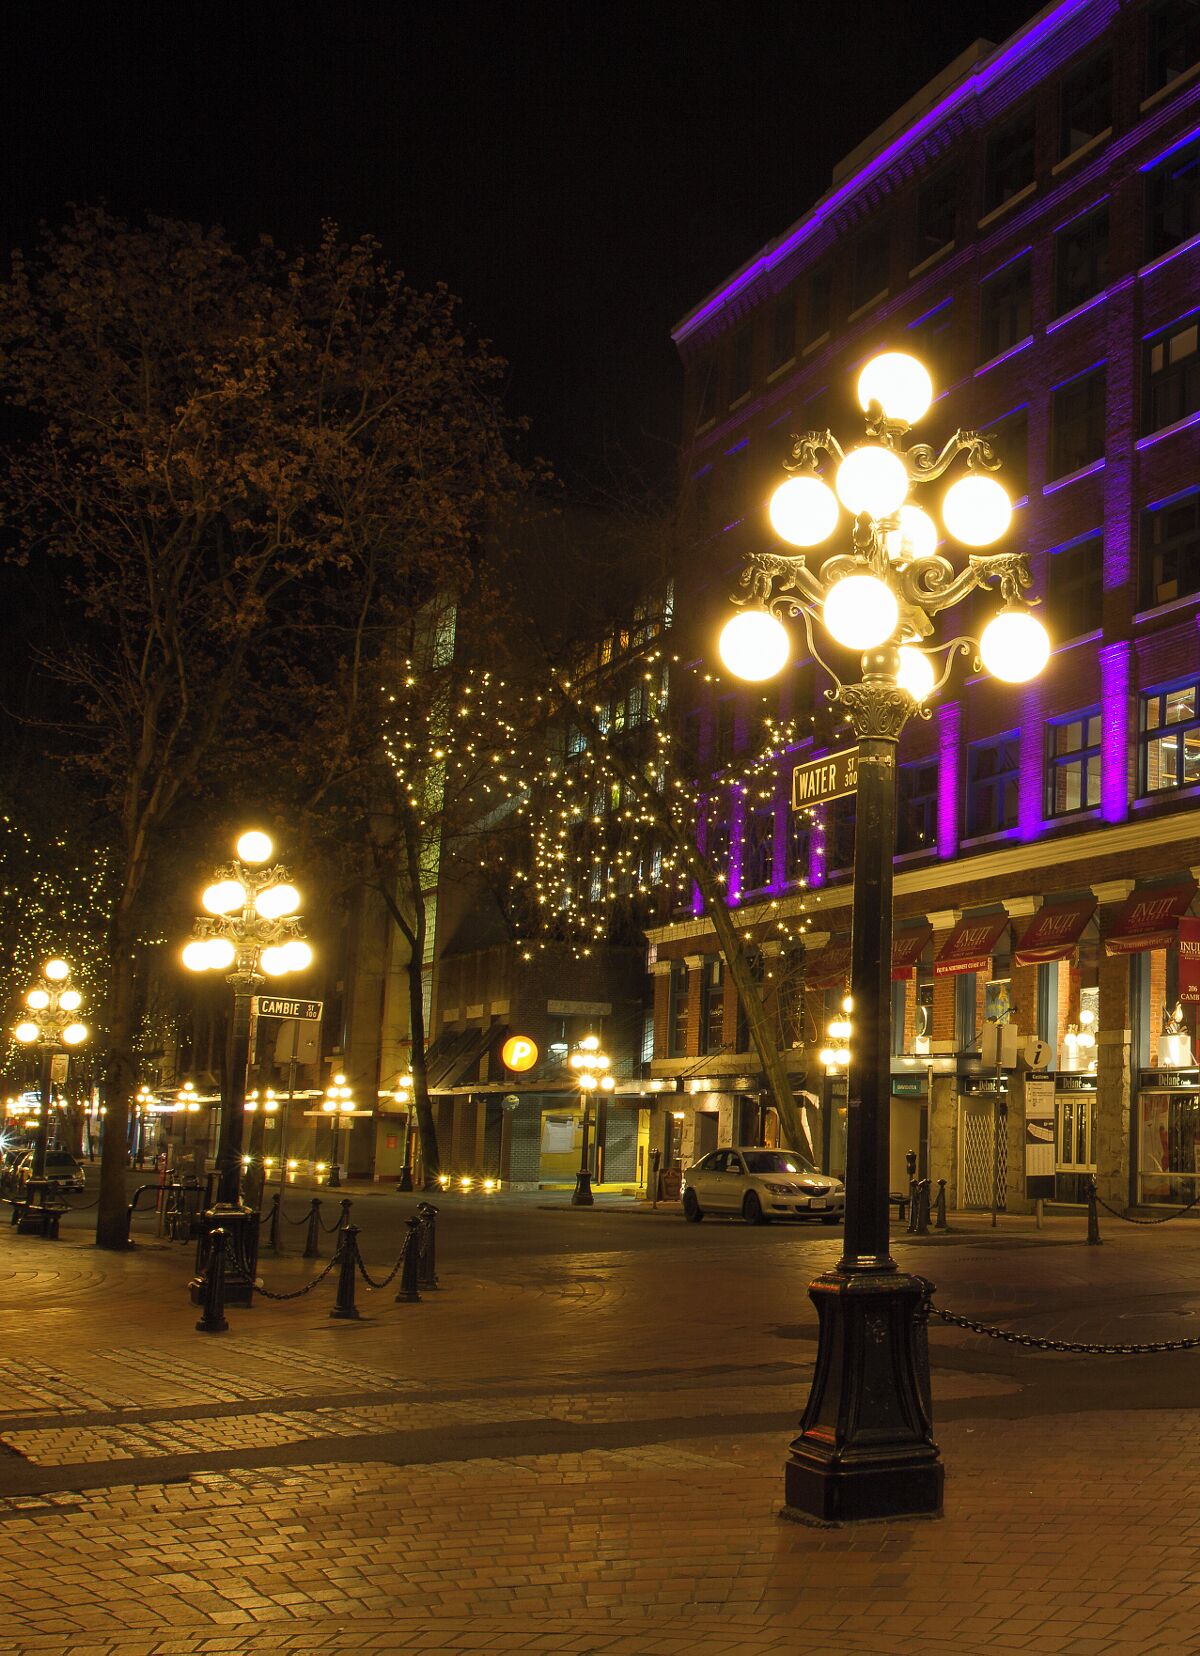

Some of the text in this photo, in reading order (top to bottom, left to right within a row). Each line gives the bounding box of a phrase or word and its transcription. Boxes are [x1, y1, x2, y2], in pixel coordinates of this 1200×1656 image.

[800, 758, 854, 800] WATER ST
[844, 771, 858, 787] 300
[1131, 896, 1178, 916] INUIT
[1040, 912, 1080, 931] INUIT
[262, 1000, 300, 1015] CAMBIE
[511, 1042, 530, 1066] P
